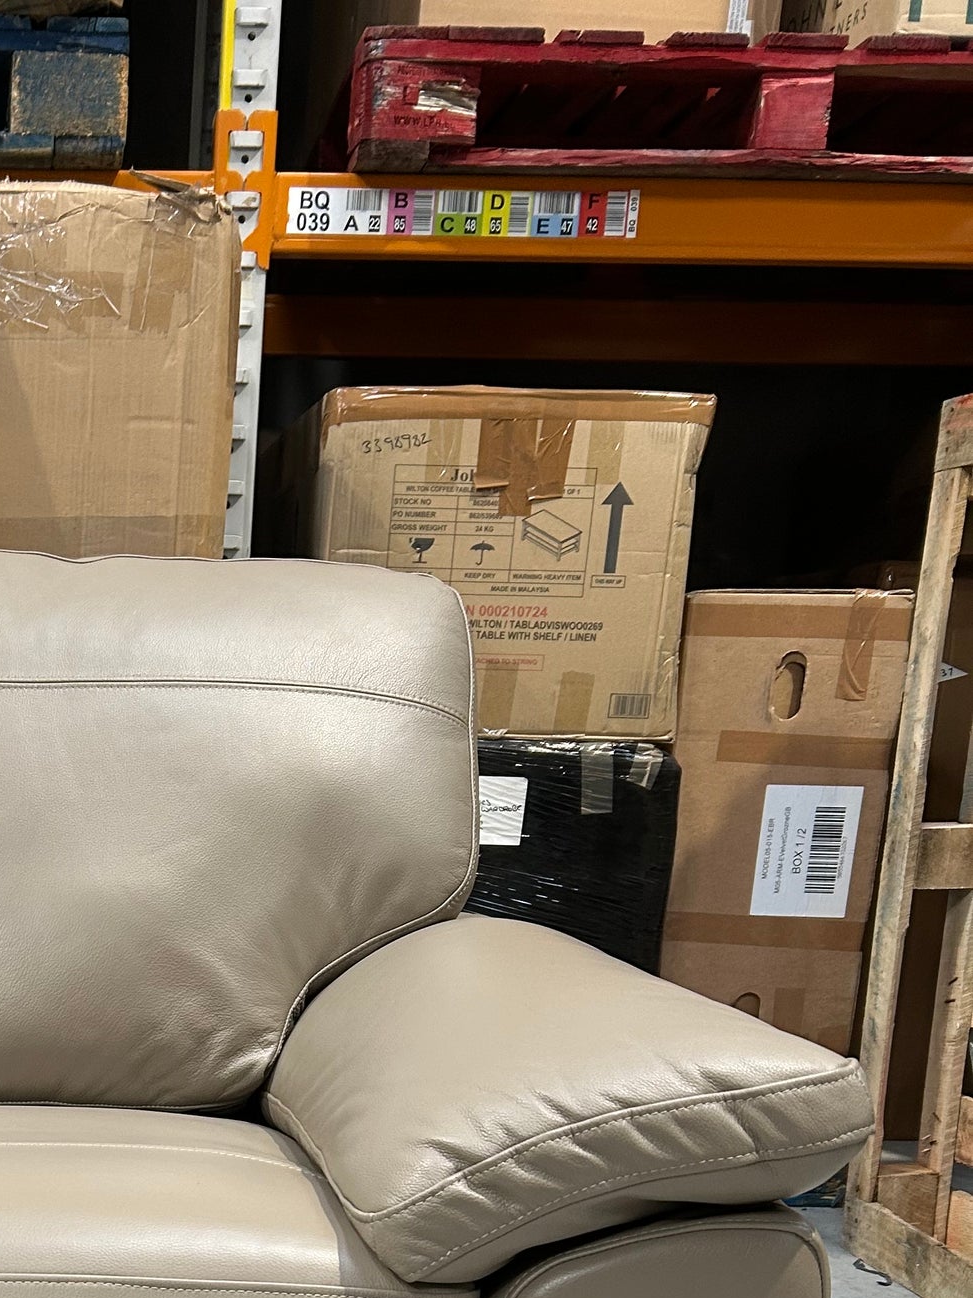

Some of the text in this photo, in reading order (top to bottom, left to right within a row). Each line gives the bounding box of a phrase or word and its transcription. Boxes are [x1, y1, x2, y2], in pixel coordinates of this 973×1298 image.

[300, 190, 330, 211] BQ
[394, 192, 408, 208] B
[490, 194, 505, 210] D
[588, 194, 601, 209] F
[296, 212, 330, 232] 039
[628, 196, 638, 232] BQ 039
[343, 215, 380, 231] A 22
[393, 217, 406, 232] 85
[440, 216, 476, 233] C 48
[489, 219, 501, 232] 65
[536, 218, 573, 234] E 47
[586, 218, 598, 232] 42
[361, 432, 433, 454] 3398982
[394, 497, 432, 506] STOCK NO
[392, 510, 404, 518] PO
[391, 523, 418, 531] GROSS
[479, 604, 548, 618] 000210724
[476, 630, 506, 640] TABLE
[507, 631, 530, 640] WITH
[533, 632, 563, 641] SHELF
[569, 633, 597, 642] LINEN
[791, 850, 804, 874] BOX
